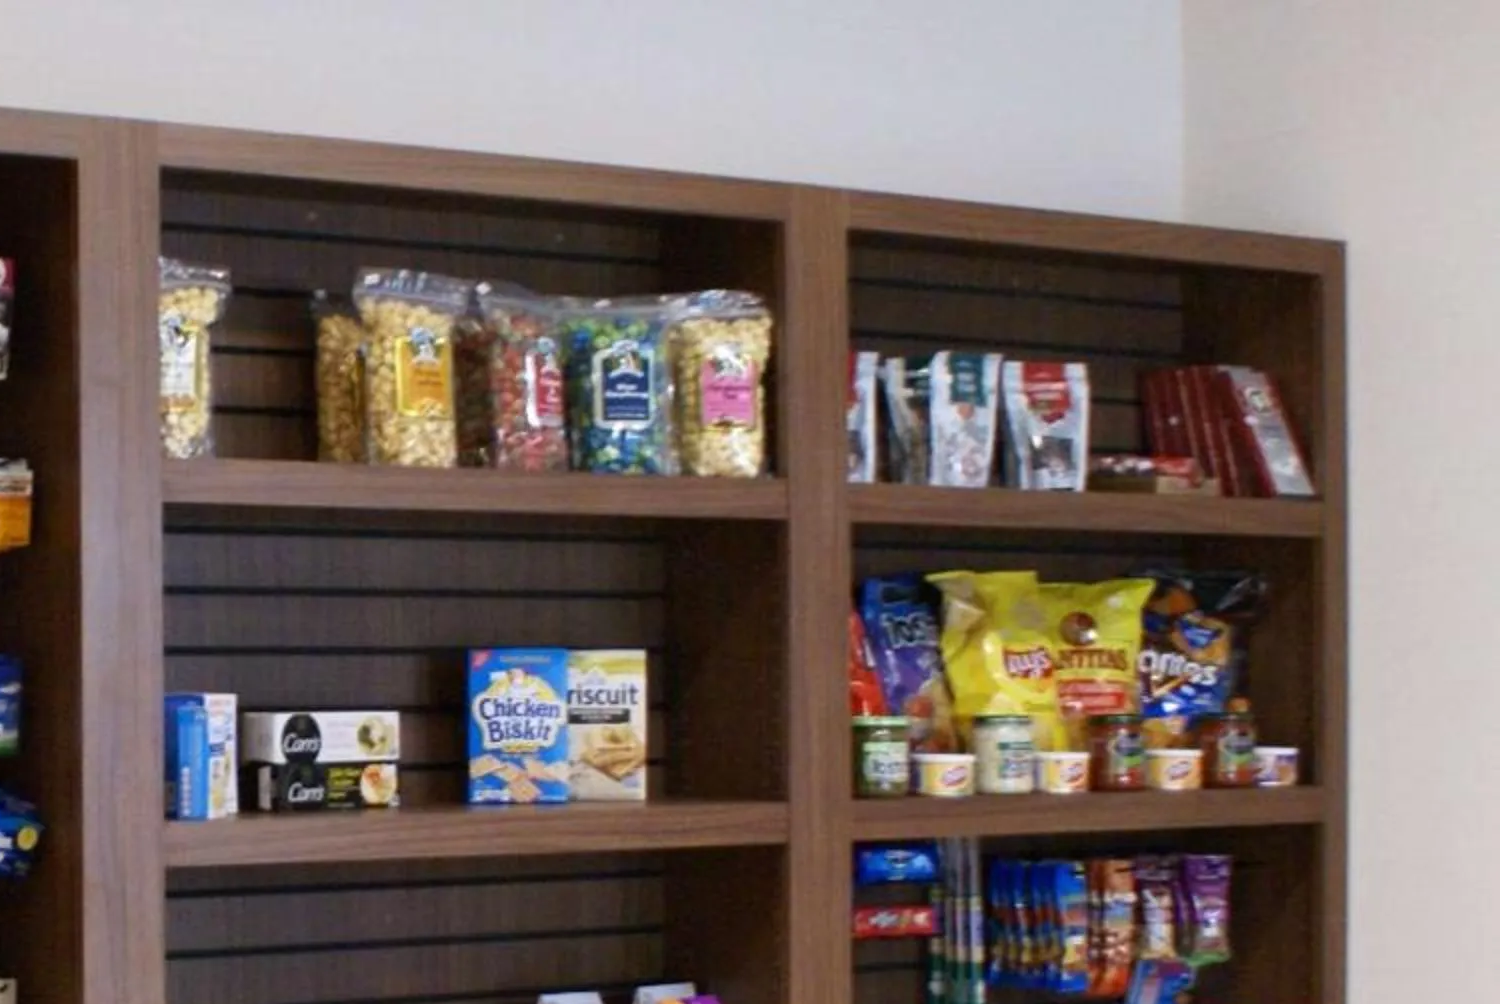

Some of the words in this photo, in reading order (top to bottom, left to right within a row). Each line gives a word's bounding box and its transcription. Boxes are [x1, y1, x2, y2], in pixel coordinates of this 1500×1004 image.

[1136, 648, 1217, 686] oritos
[567, 683, 640, 706] riscuit
[478, 697, 561, 719] Chicken
[488, 718, 552, 742] Biskit
